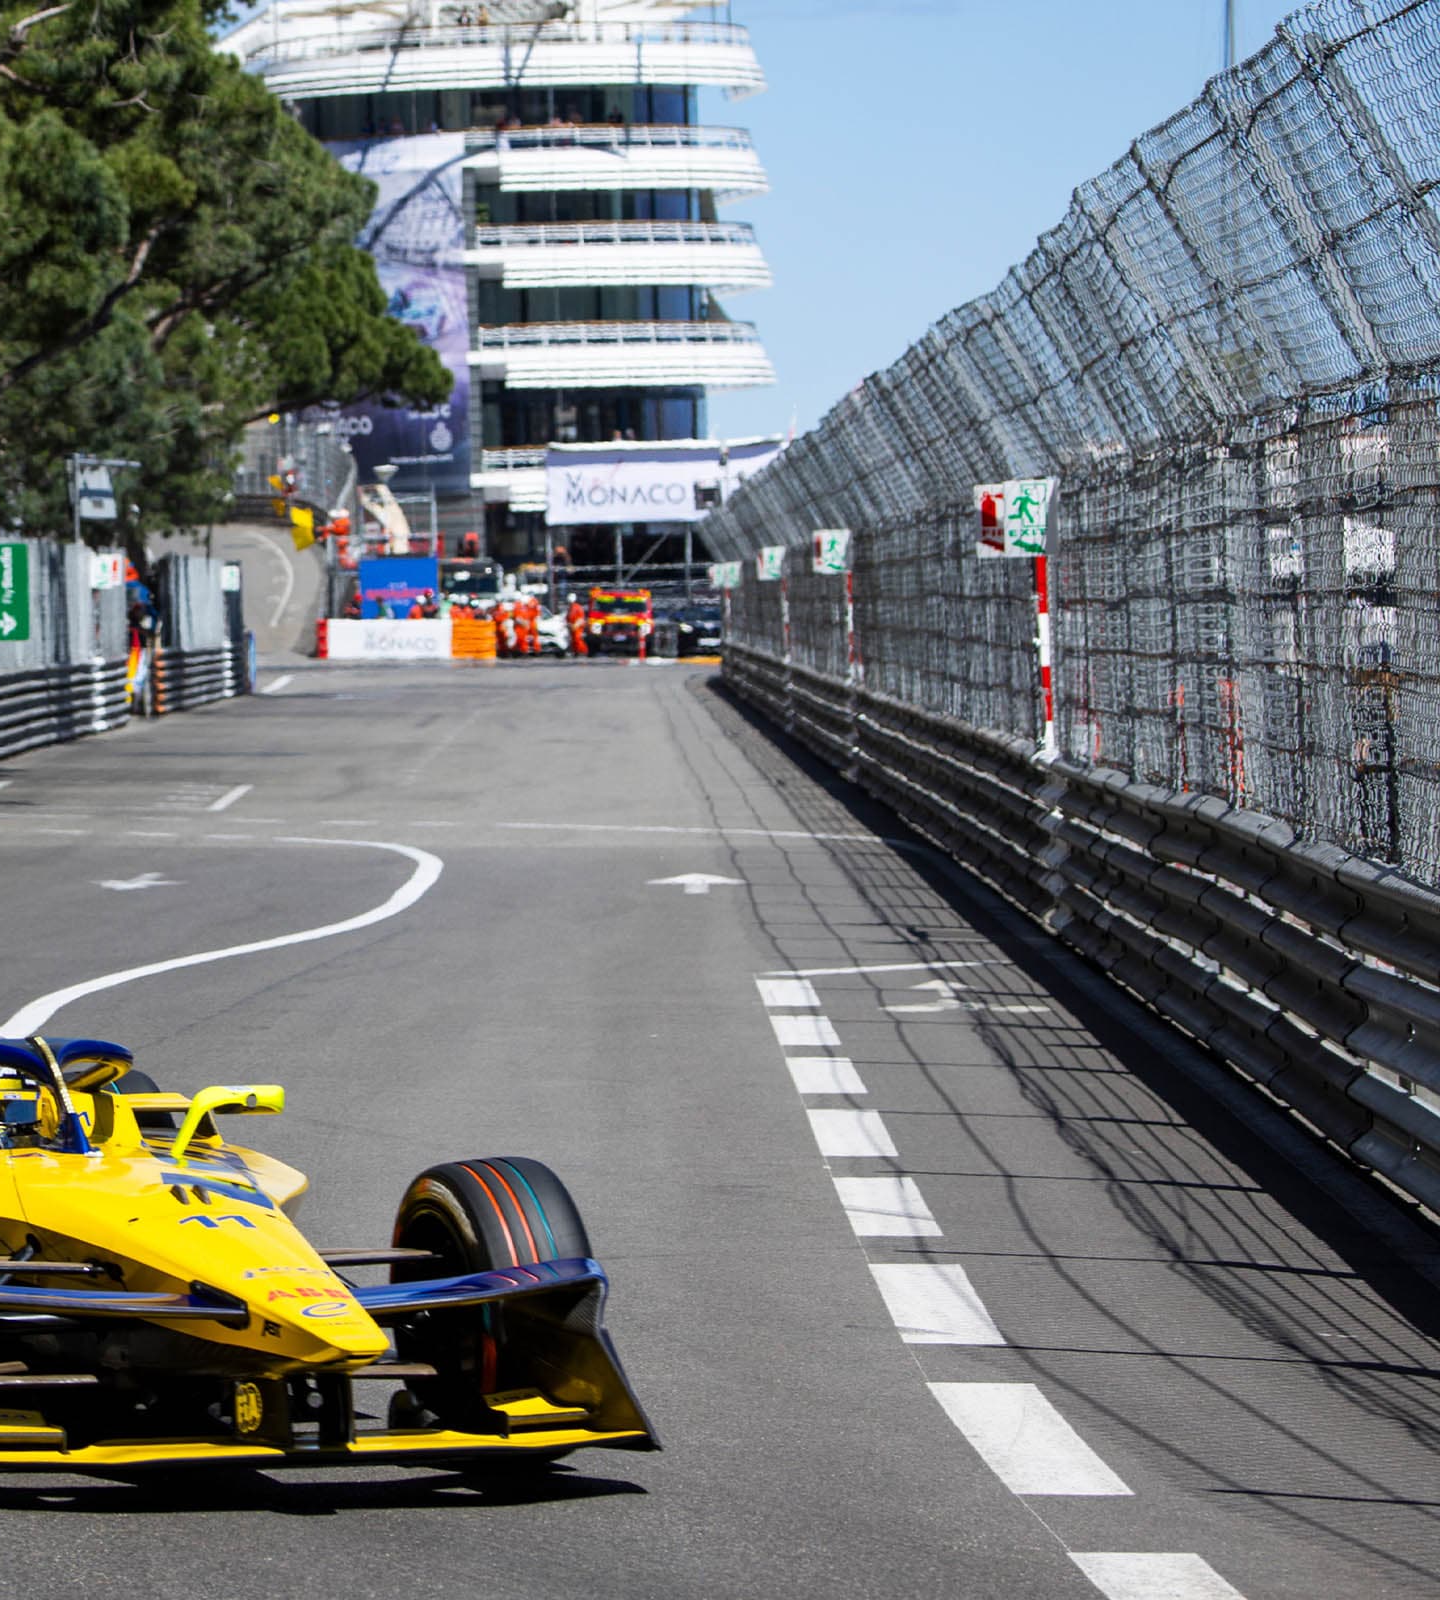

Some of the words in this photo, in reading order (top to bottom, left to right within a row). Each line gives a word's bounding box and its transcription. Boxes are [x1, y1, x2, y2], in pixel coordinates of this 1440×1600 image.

[566, 483, 686, 507] MONACO
[178, 1215, 257, 1229] 11
[267, 1287, 352, 1302] ABB
